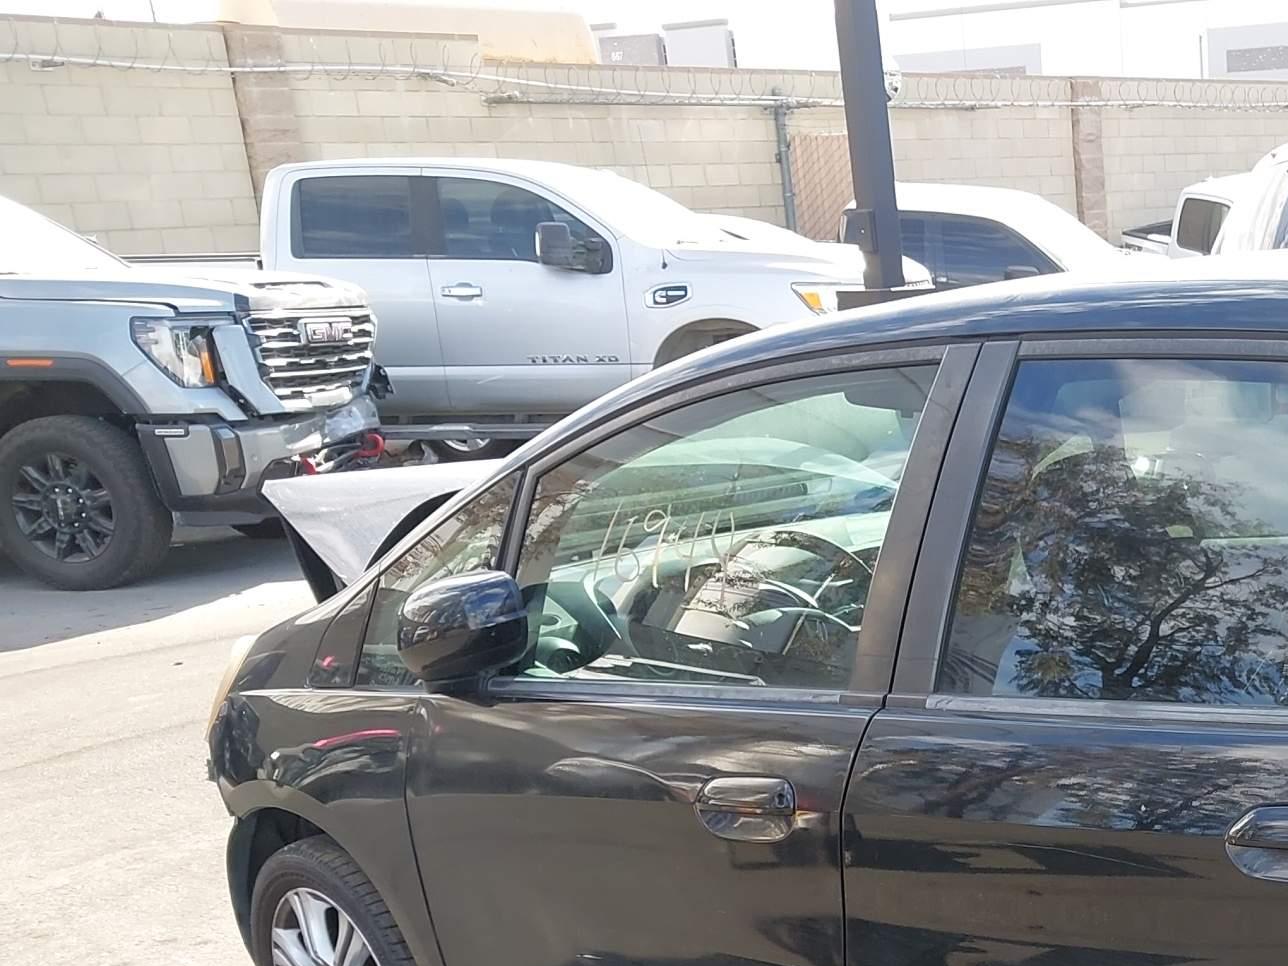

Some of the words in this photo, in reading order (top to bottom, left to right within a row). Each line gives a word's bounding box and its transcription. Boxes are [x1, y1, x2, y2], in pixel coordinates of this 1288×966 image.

[304, 321, 352, 342] GMC
[526, 354, 588, 364] TITAN
[595, 354, 620, 363] XD
